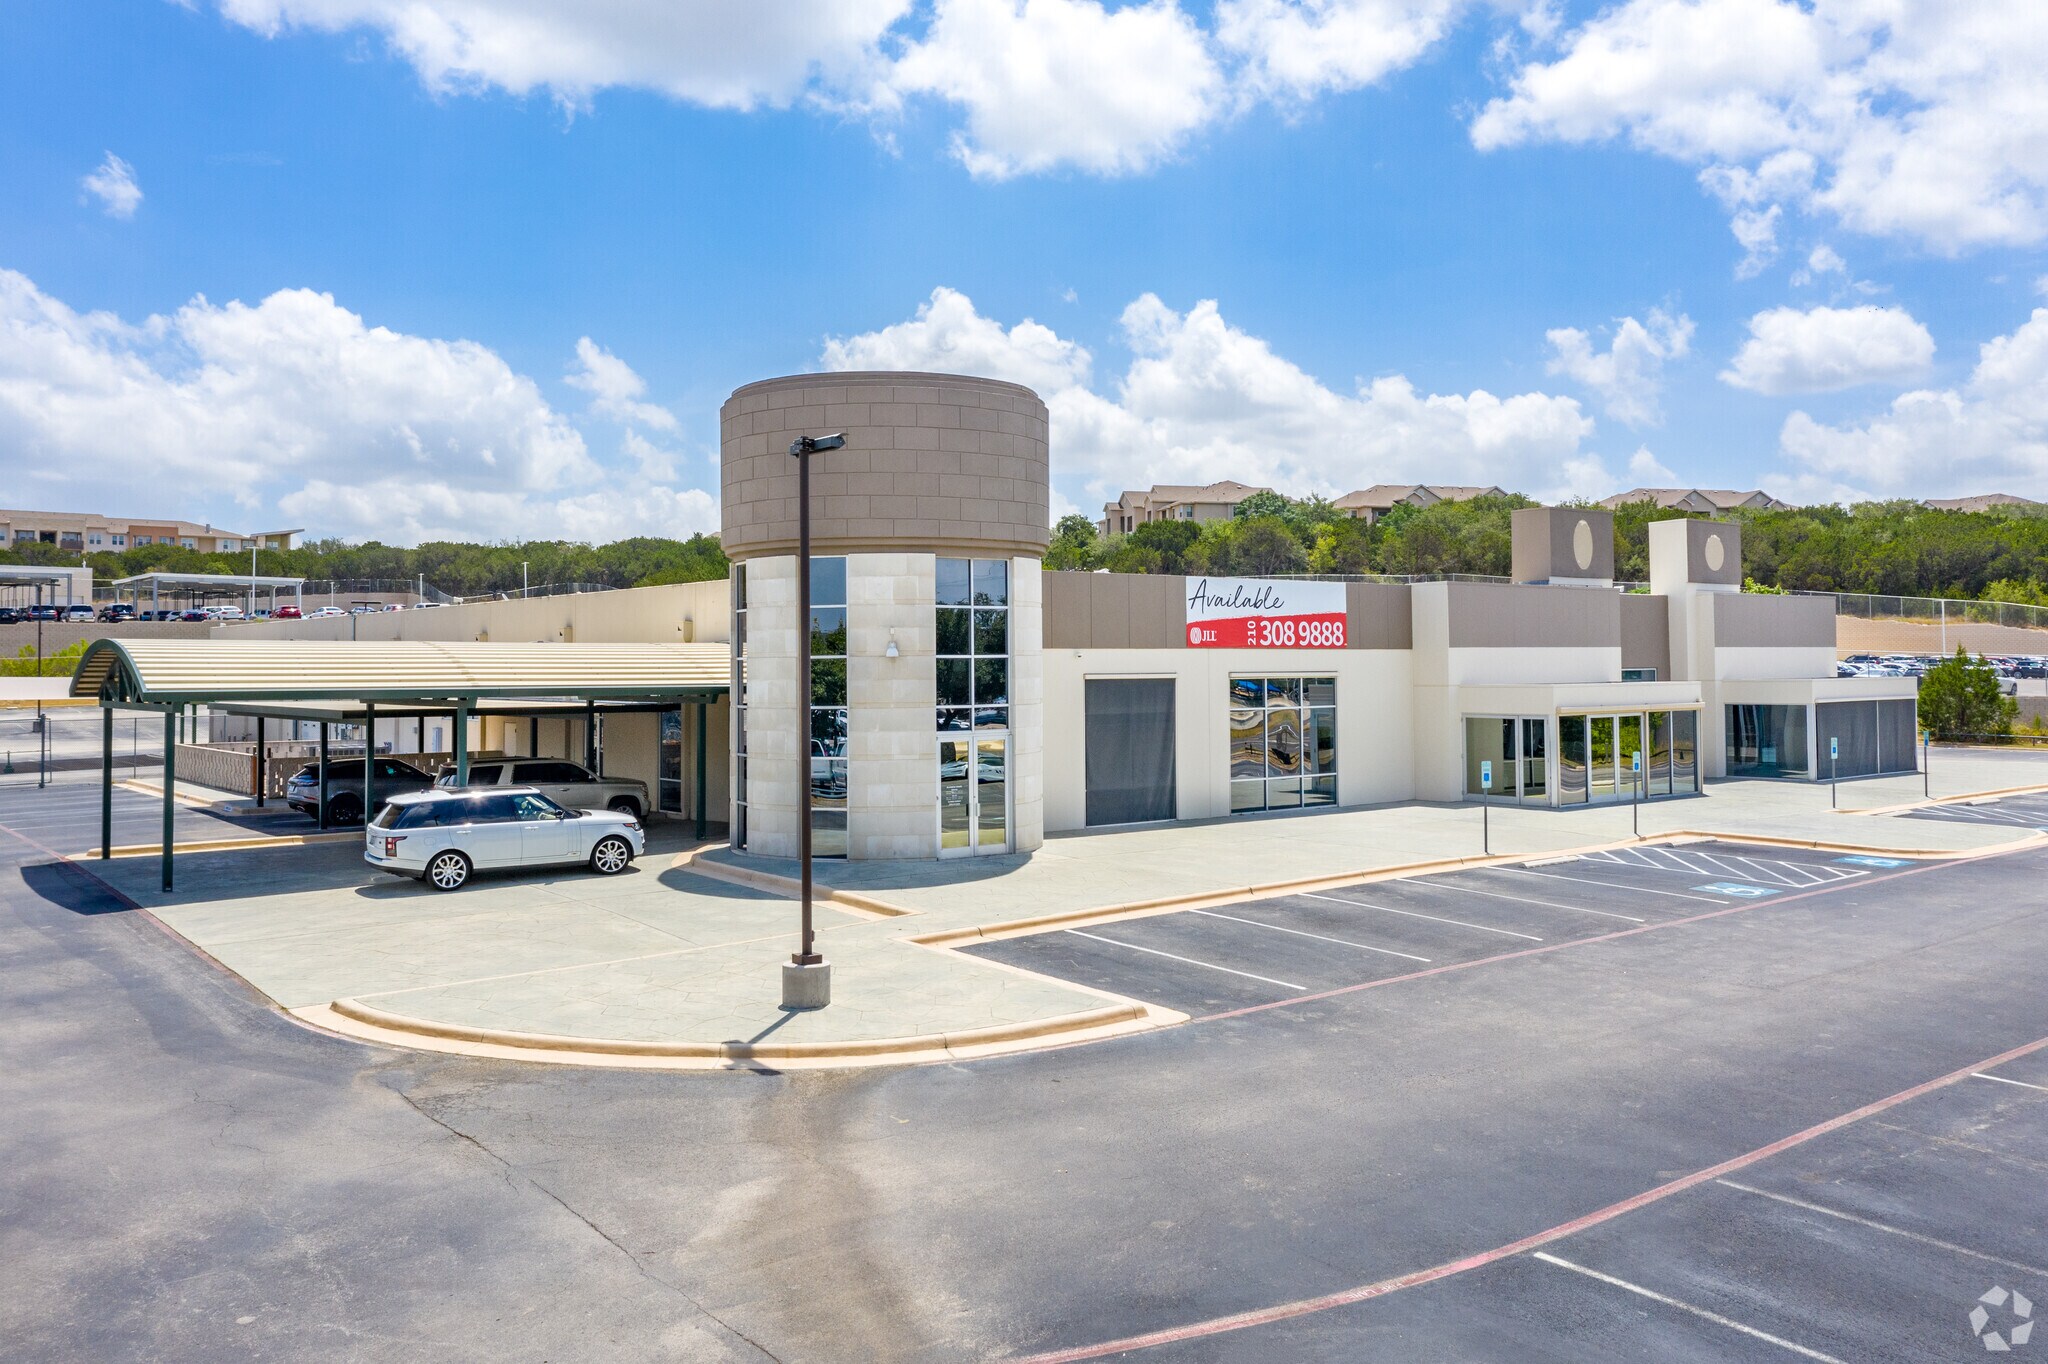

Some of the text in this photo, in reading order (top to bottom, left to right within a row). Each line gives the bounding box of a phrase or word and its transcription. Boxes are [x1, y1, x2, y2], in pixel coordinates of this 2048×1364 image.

[1188, 578, 1285, 614] Available
[1201, 630, 1217, 642] JLL
[1247, 620, 1344, 647] 210 308 9888
